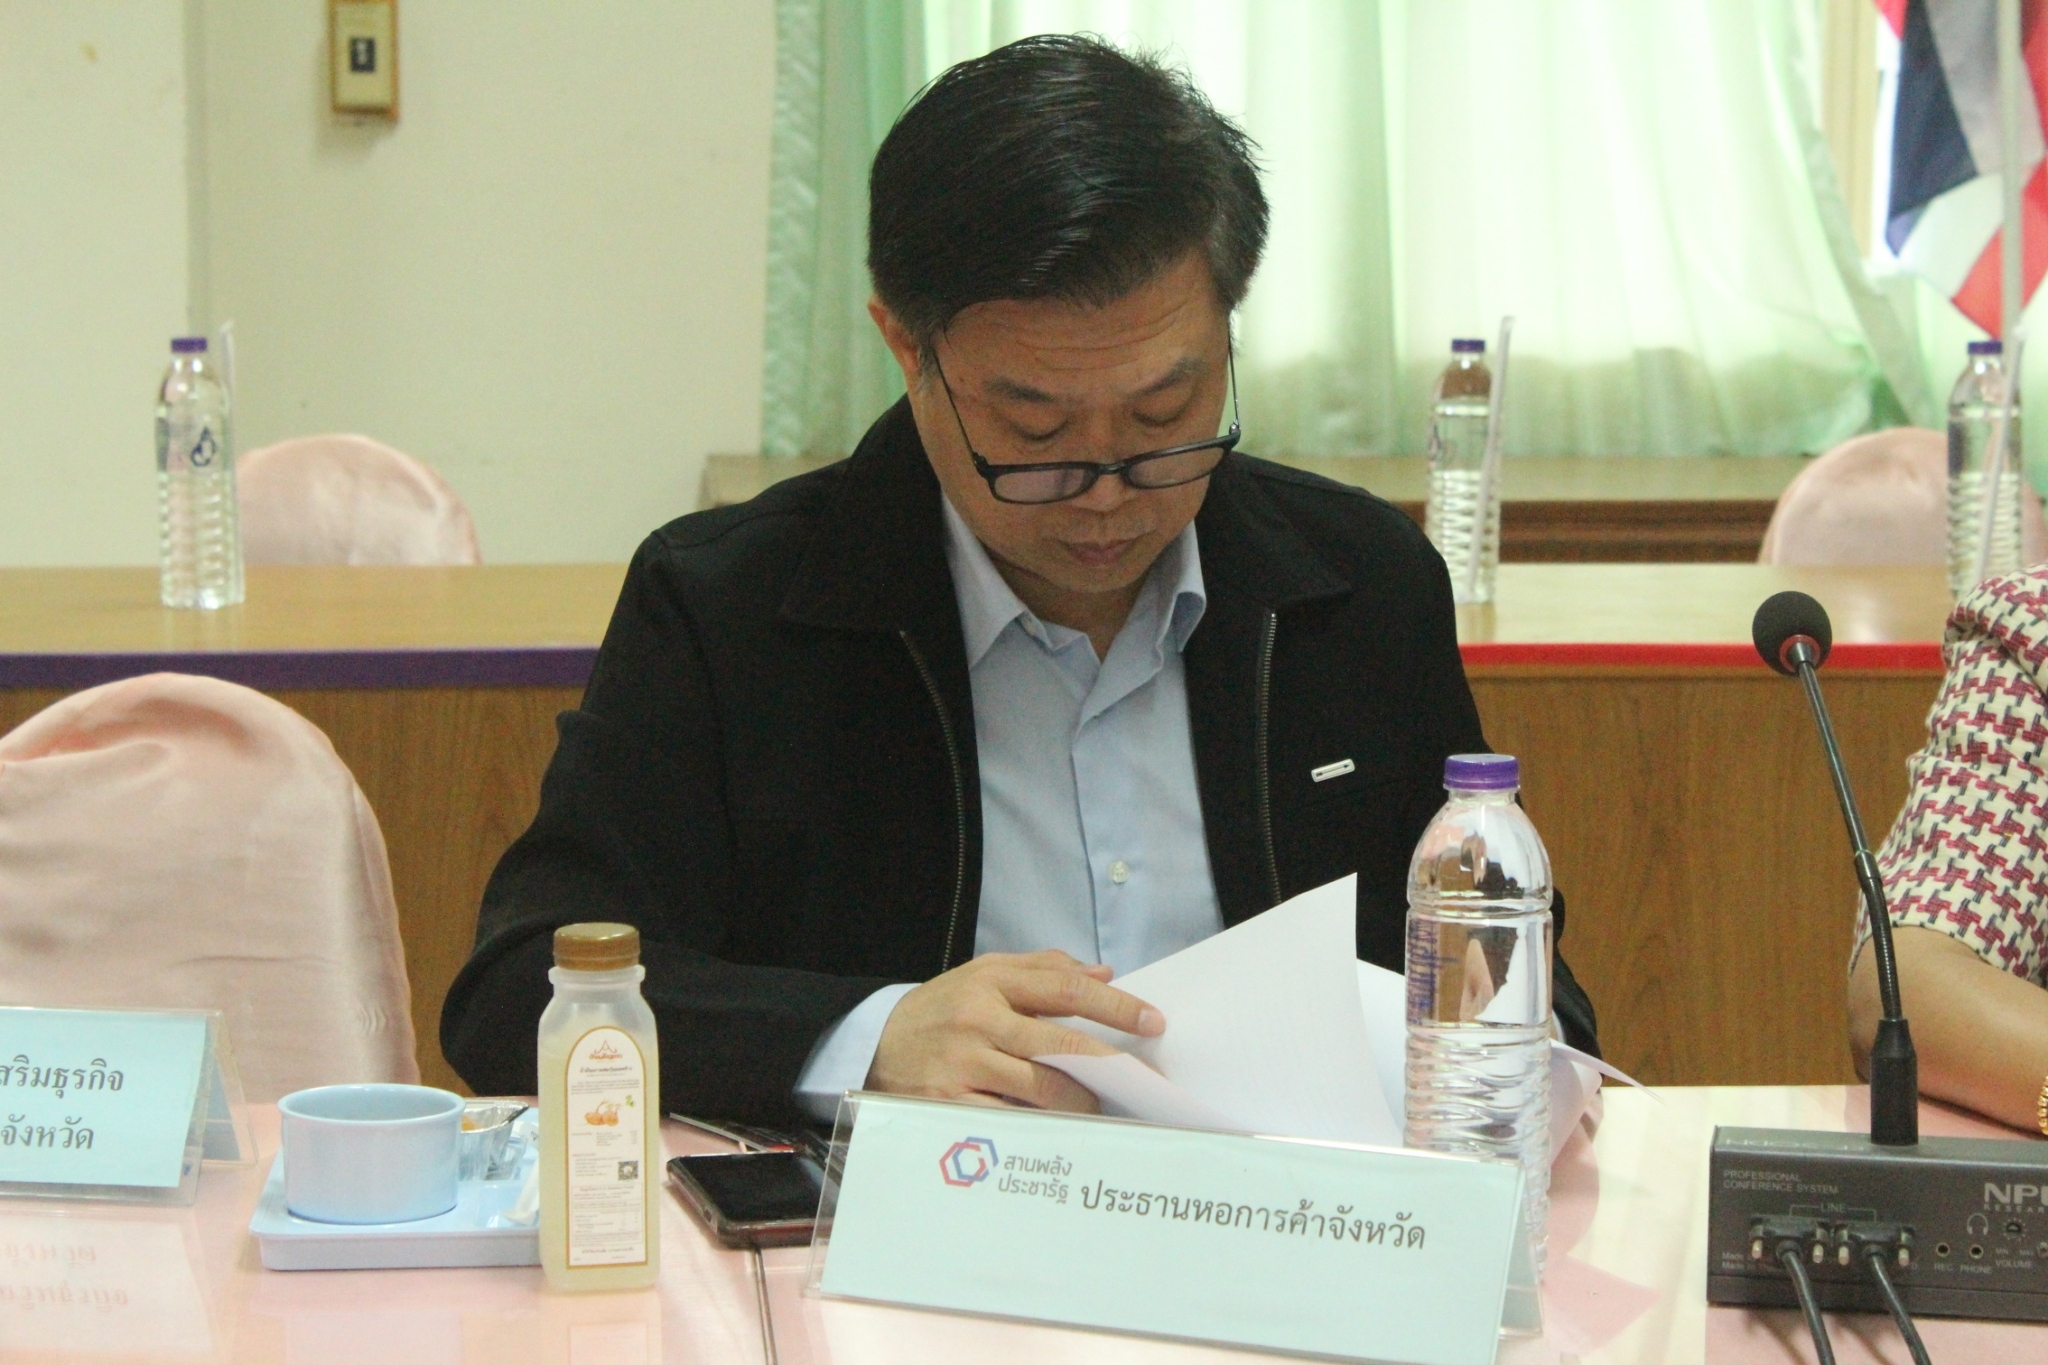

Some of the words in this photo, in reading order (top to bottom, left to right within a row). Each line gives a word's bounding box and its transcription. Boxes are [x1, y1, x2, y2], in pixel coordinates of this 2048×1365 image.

[0, 1054, 124, 1099] สริมธุรกิจ
[1, 1113, 94, 1150] จังหวัด
[1004, 1154, 1073, 1177] สานพลัง
[1723, 1169, 1801, 1183] PROFESSIONAL
[998, 1172, 1069, 1204] ประชารัฐ
[1723, 1180, 1793, 1193] CONFERENCE
[1796, 1183, 1839, 1195] SYSTEM
[1081, 1179, 1426, 1250] ประธานหอการค้าจังหวัด
[1820, 1202, 1847, 1214] LINE
[1960, 1264, 1993, 1275] PHONE
[1995, 1260, 2033, 1269] VOLUME
